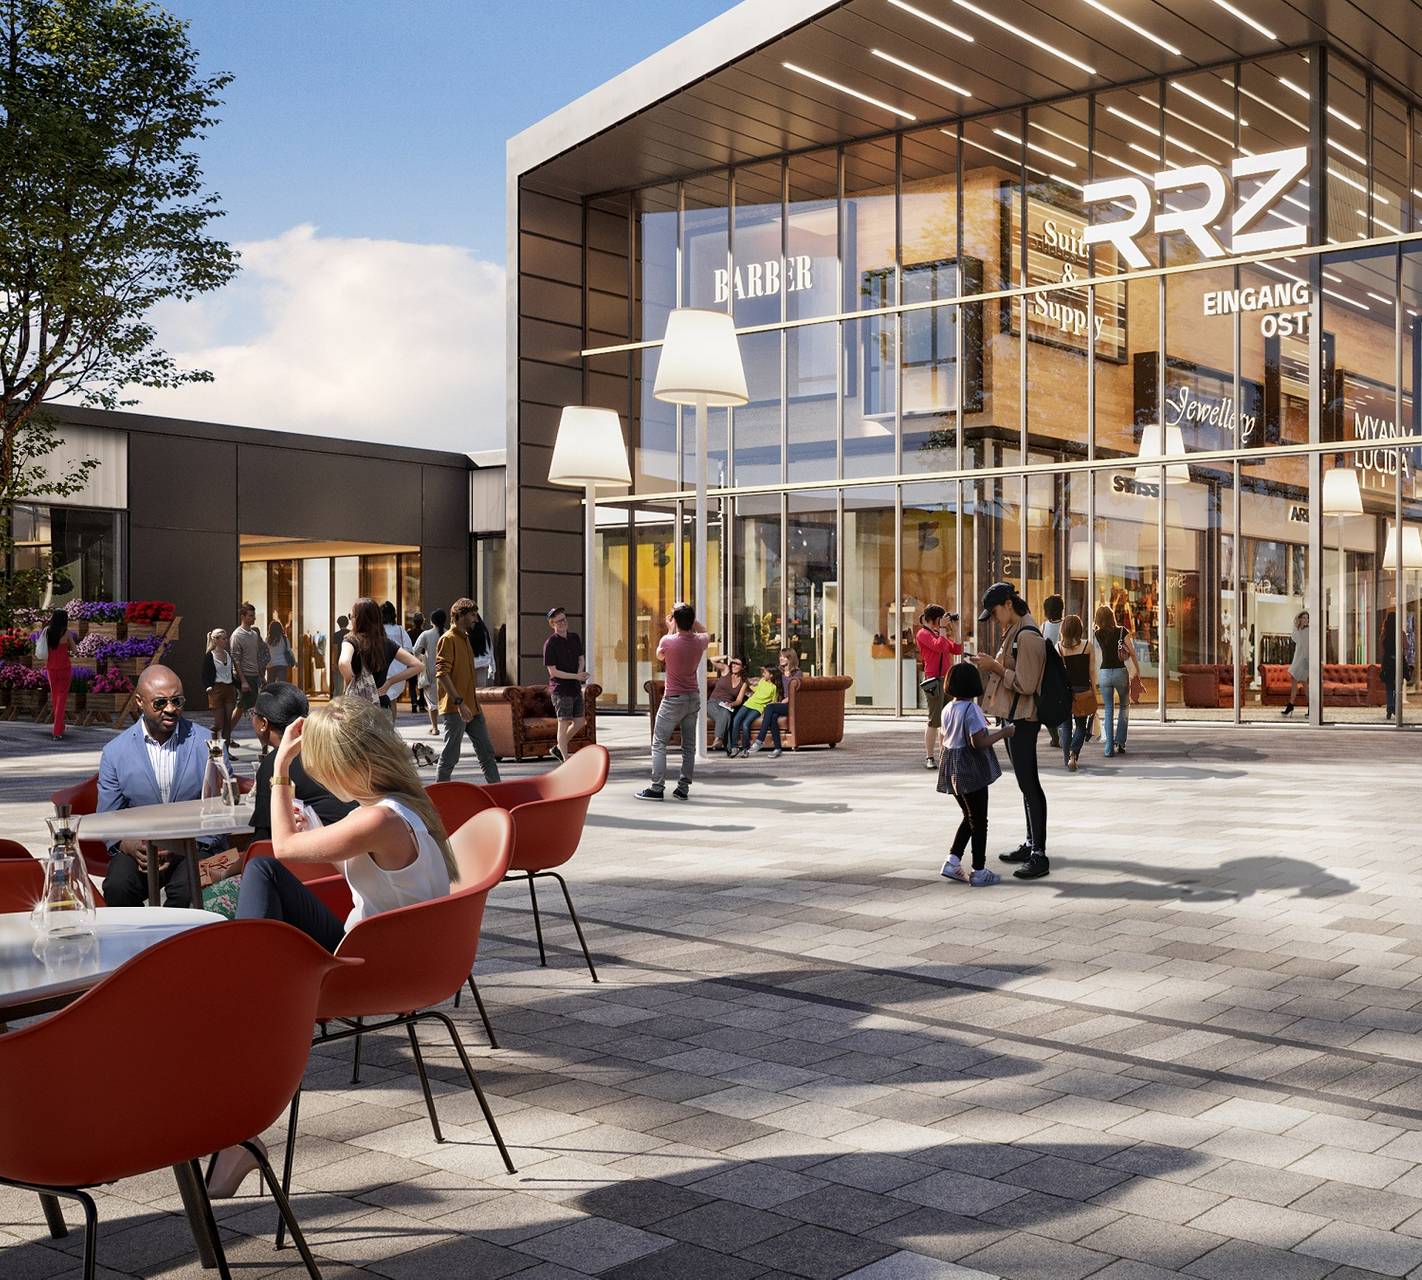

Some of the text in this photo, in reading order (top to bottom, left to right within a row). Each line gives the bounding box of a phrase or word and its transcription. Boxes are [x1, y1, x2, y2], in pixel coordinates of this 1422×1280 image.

[1083, 147, 1307, 268] RRZ
[1044, 220, 1089, 258] Suit
[713, 255, 813, 303] BARBER
[1203, 282, 1309, 316] EINGANG
[1260, 312, 1310, 338] OST
[1355, 449, 1410, 479] LUCIDA
